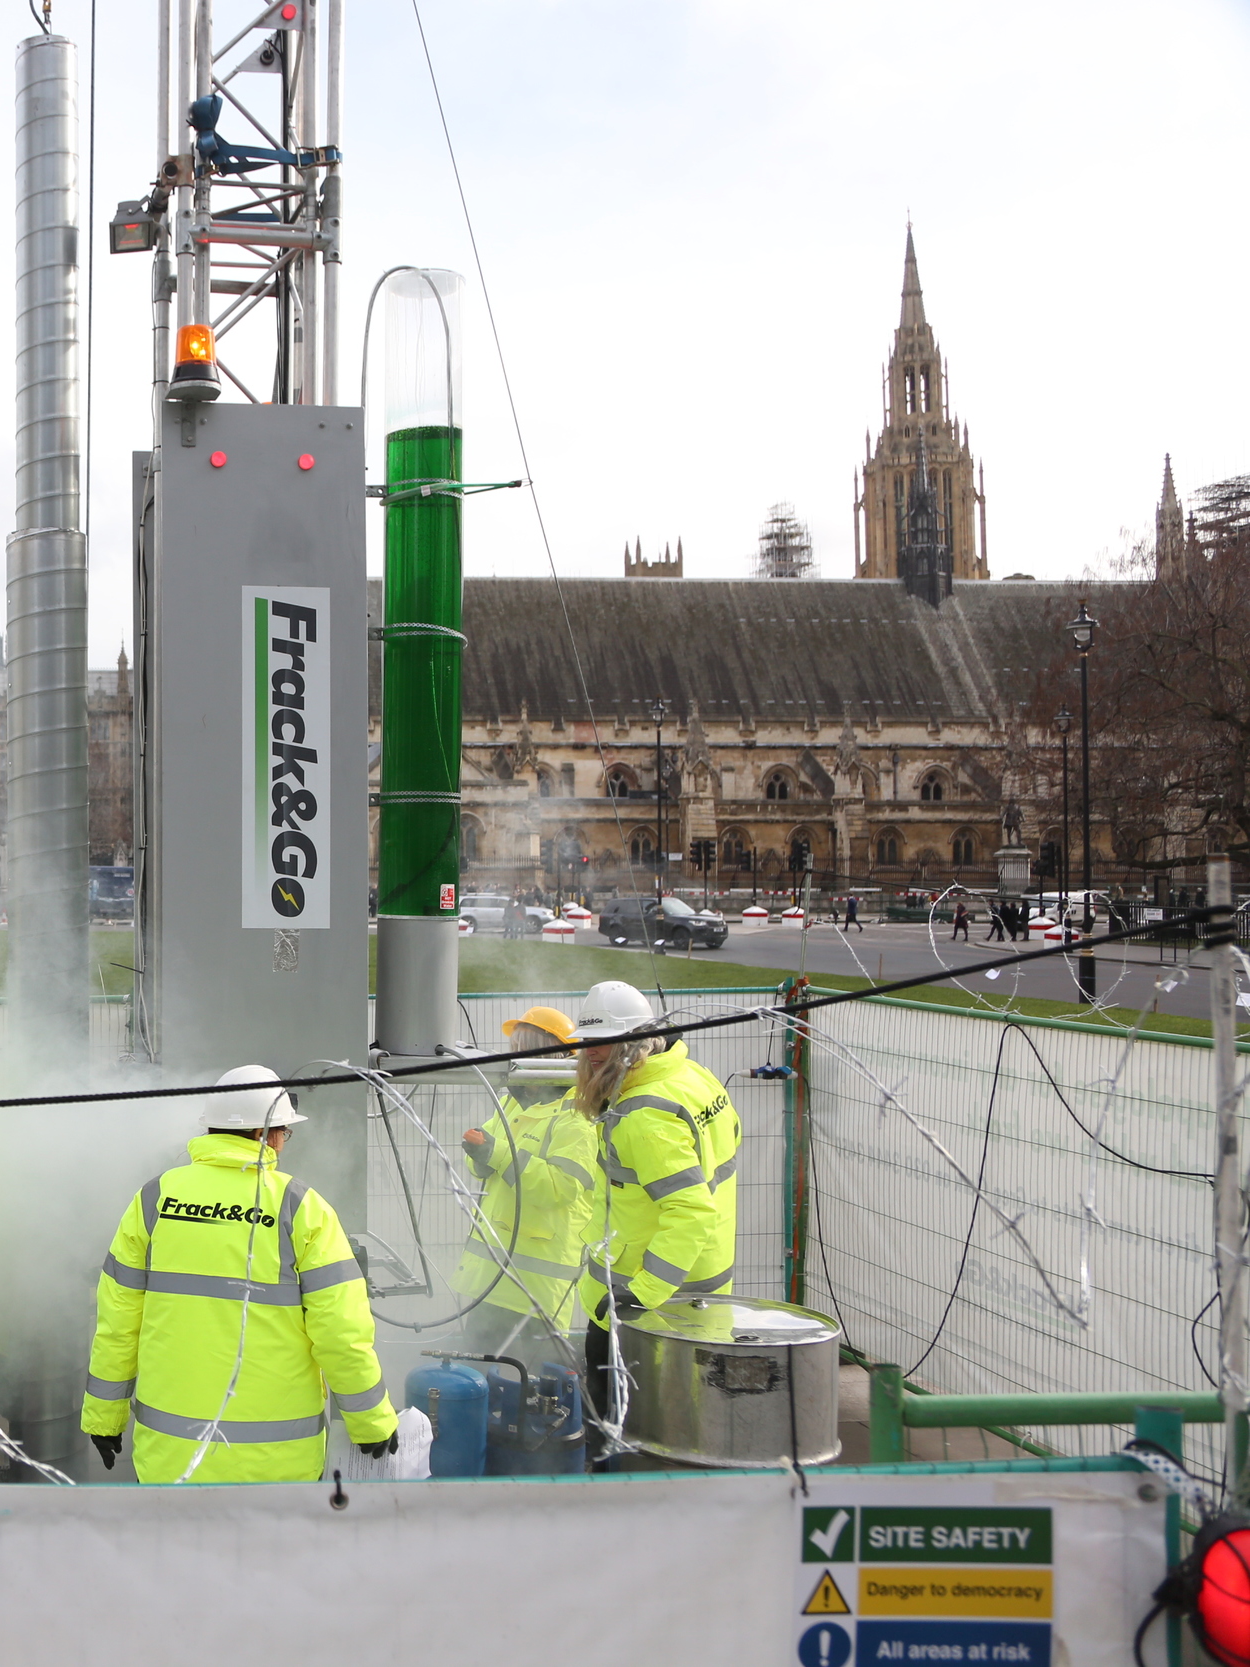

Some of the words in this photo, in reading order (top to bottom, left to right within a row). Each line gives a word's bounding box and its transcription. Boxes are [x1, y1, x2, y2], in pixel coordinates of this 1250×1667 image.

[271, 600, 318, 918] Frack&Go
[161, 1196, 275, 1228] Frack&Go
[868, 1526, 924, 1548] SITE
[931, 1527, 1031, 1549] SAFETY
[866, 1582, 924, 1599] Danger
[930, 1583, 947, 1597] to
[951, 1582, 1043, 1601] democracy
[877, 1641, 903, 1659] All
[908, 1645, 961, 1660] areas
[967, 1644, 987, 1660] at
[992, 1642, 1031, 1661] risk
